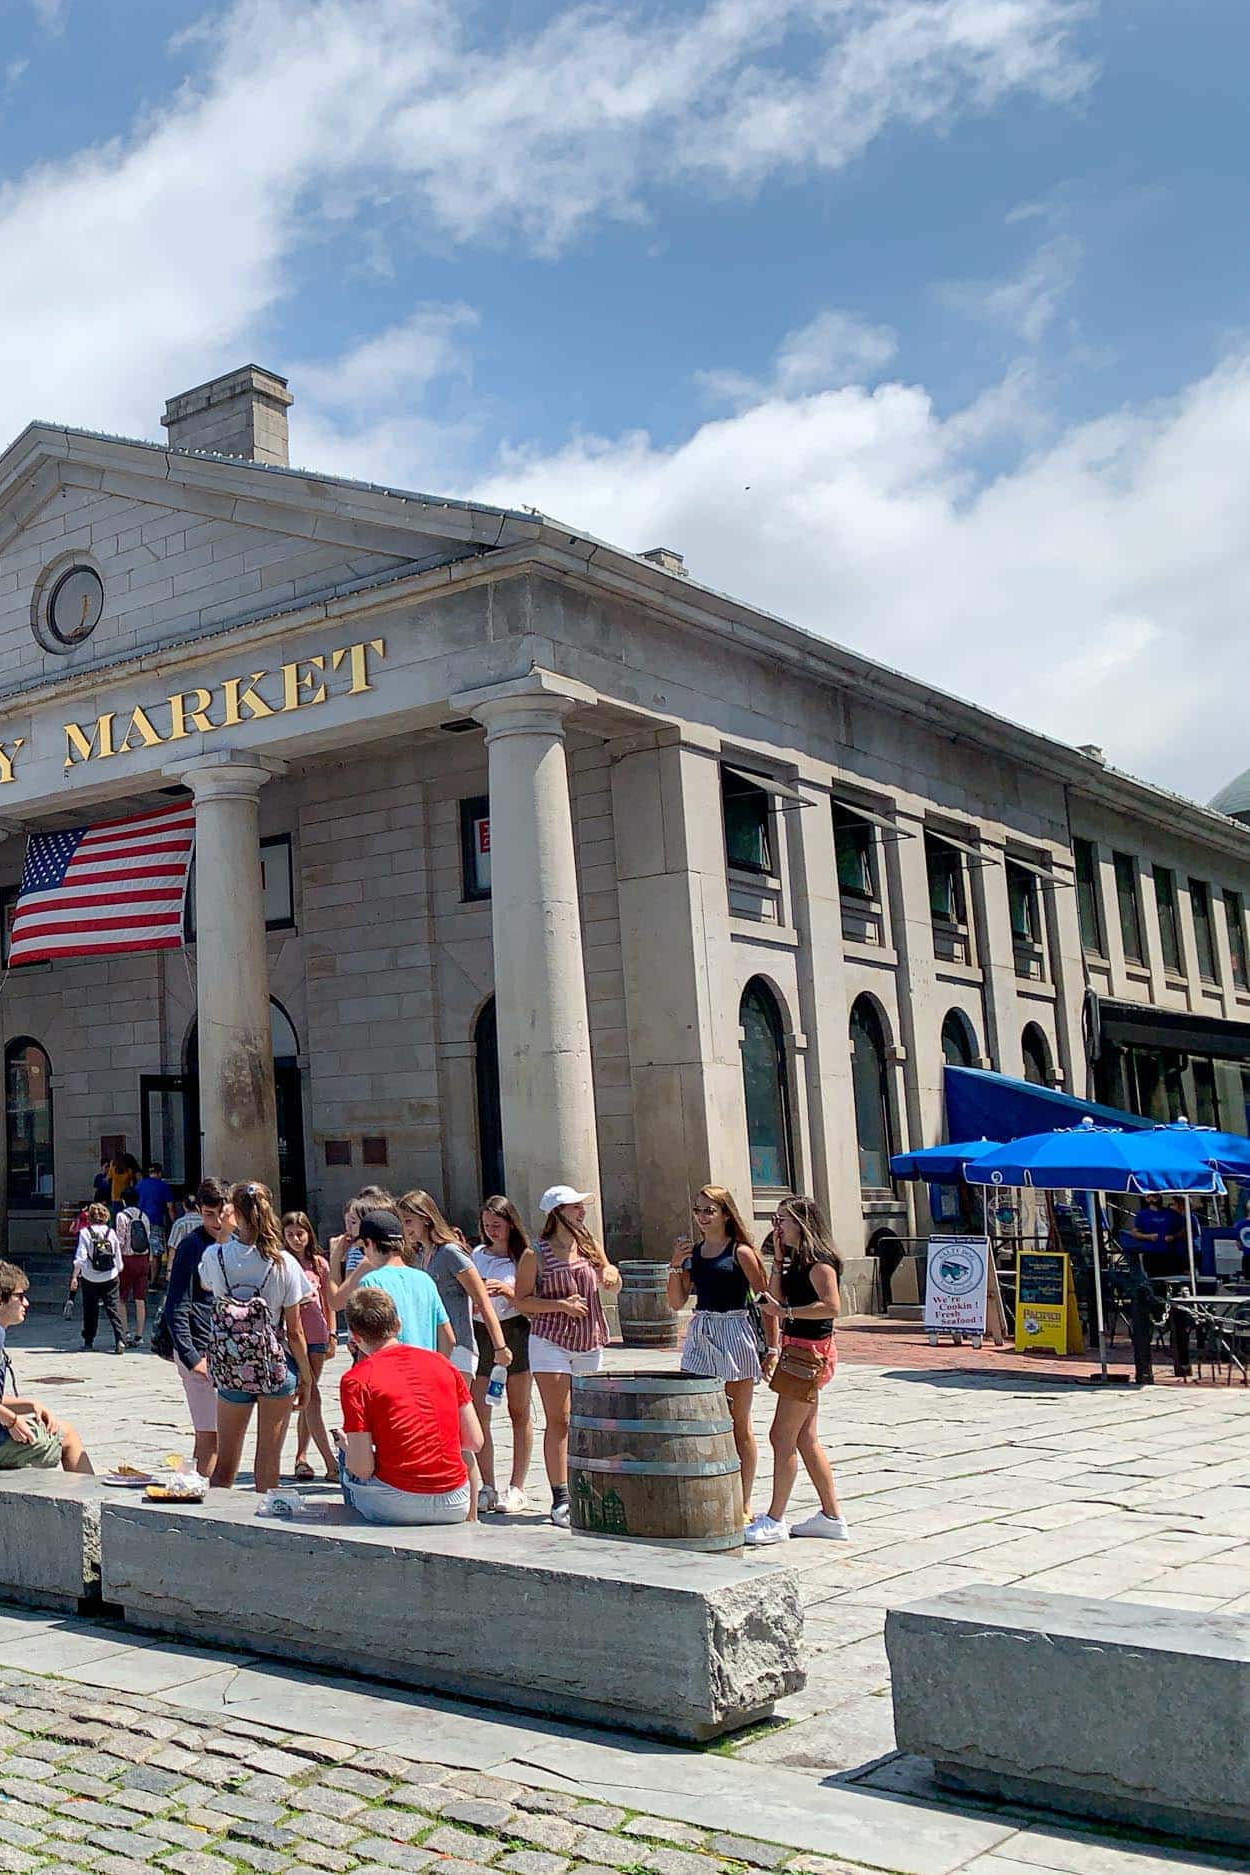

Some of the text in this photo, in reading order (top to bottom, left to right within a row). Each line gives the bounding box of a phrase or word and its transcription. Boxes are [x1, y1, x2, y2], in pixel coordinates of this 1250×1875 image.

[63, 638, 387, 767] MARKET
[933, 1295, 961, 1304] We're
[939, 1302, 973, 1311] Cookin
[935, 1310, 961, 1319] Fresh
[941, 1315, 976, 1325] Seafood
